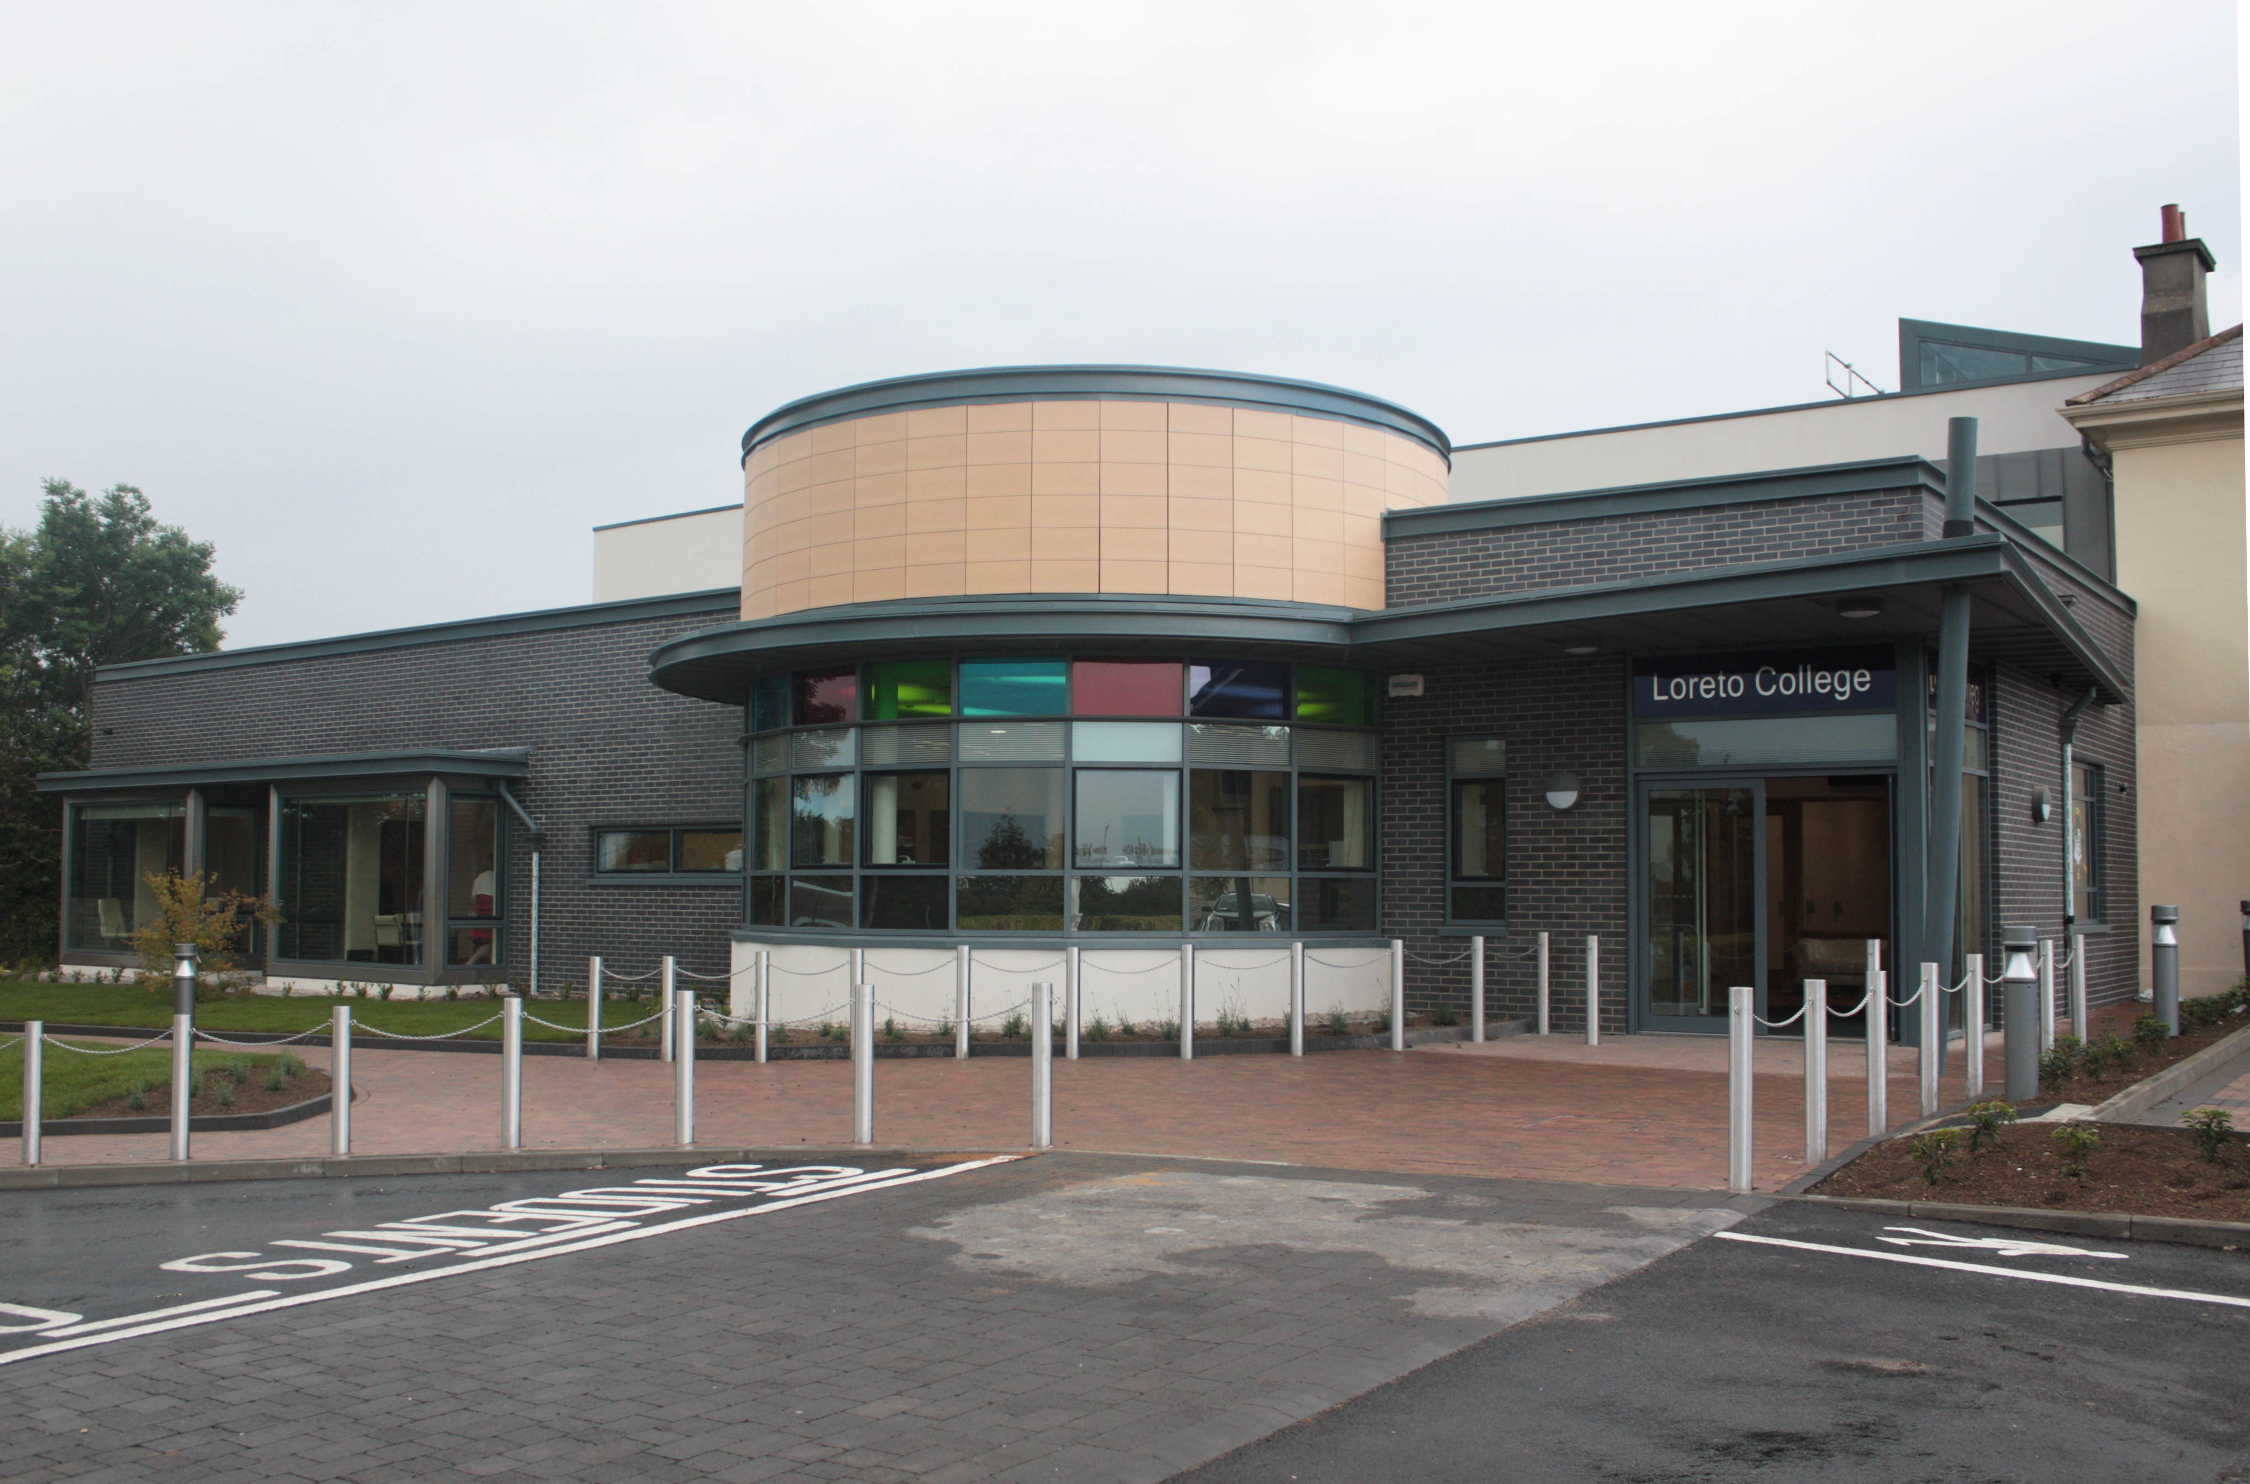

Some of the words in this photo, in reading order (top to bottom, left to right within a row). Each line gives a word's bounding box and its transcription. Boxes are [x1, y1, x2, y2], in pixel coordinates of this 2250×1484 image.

[1653, 671, 1744, 700] Loreto
[1755, 664, 1871, 700] College
[160, 1164, 863, 1280] STUDENTS
